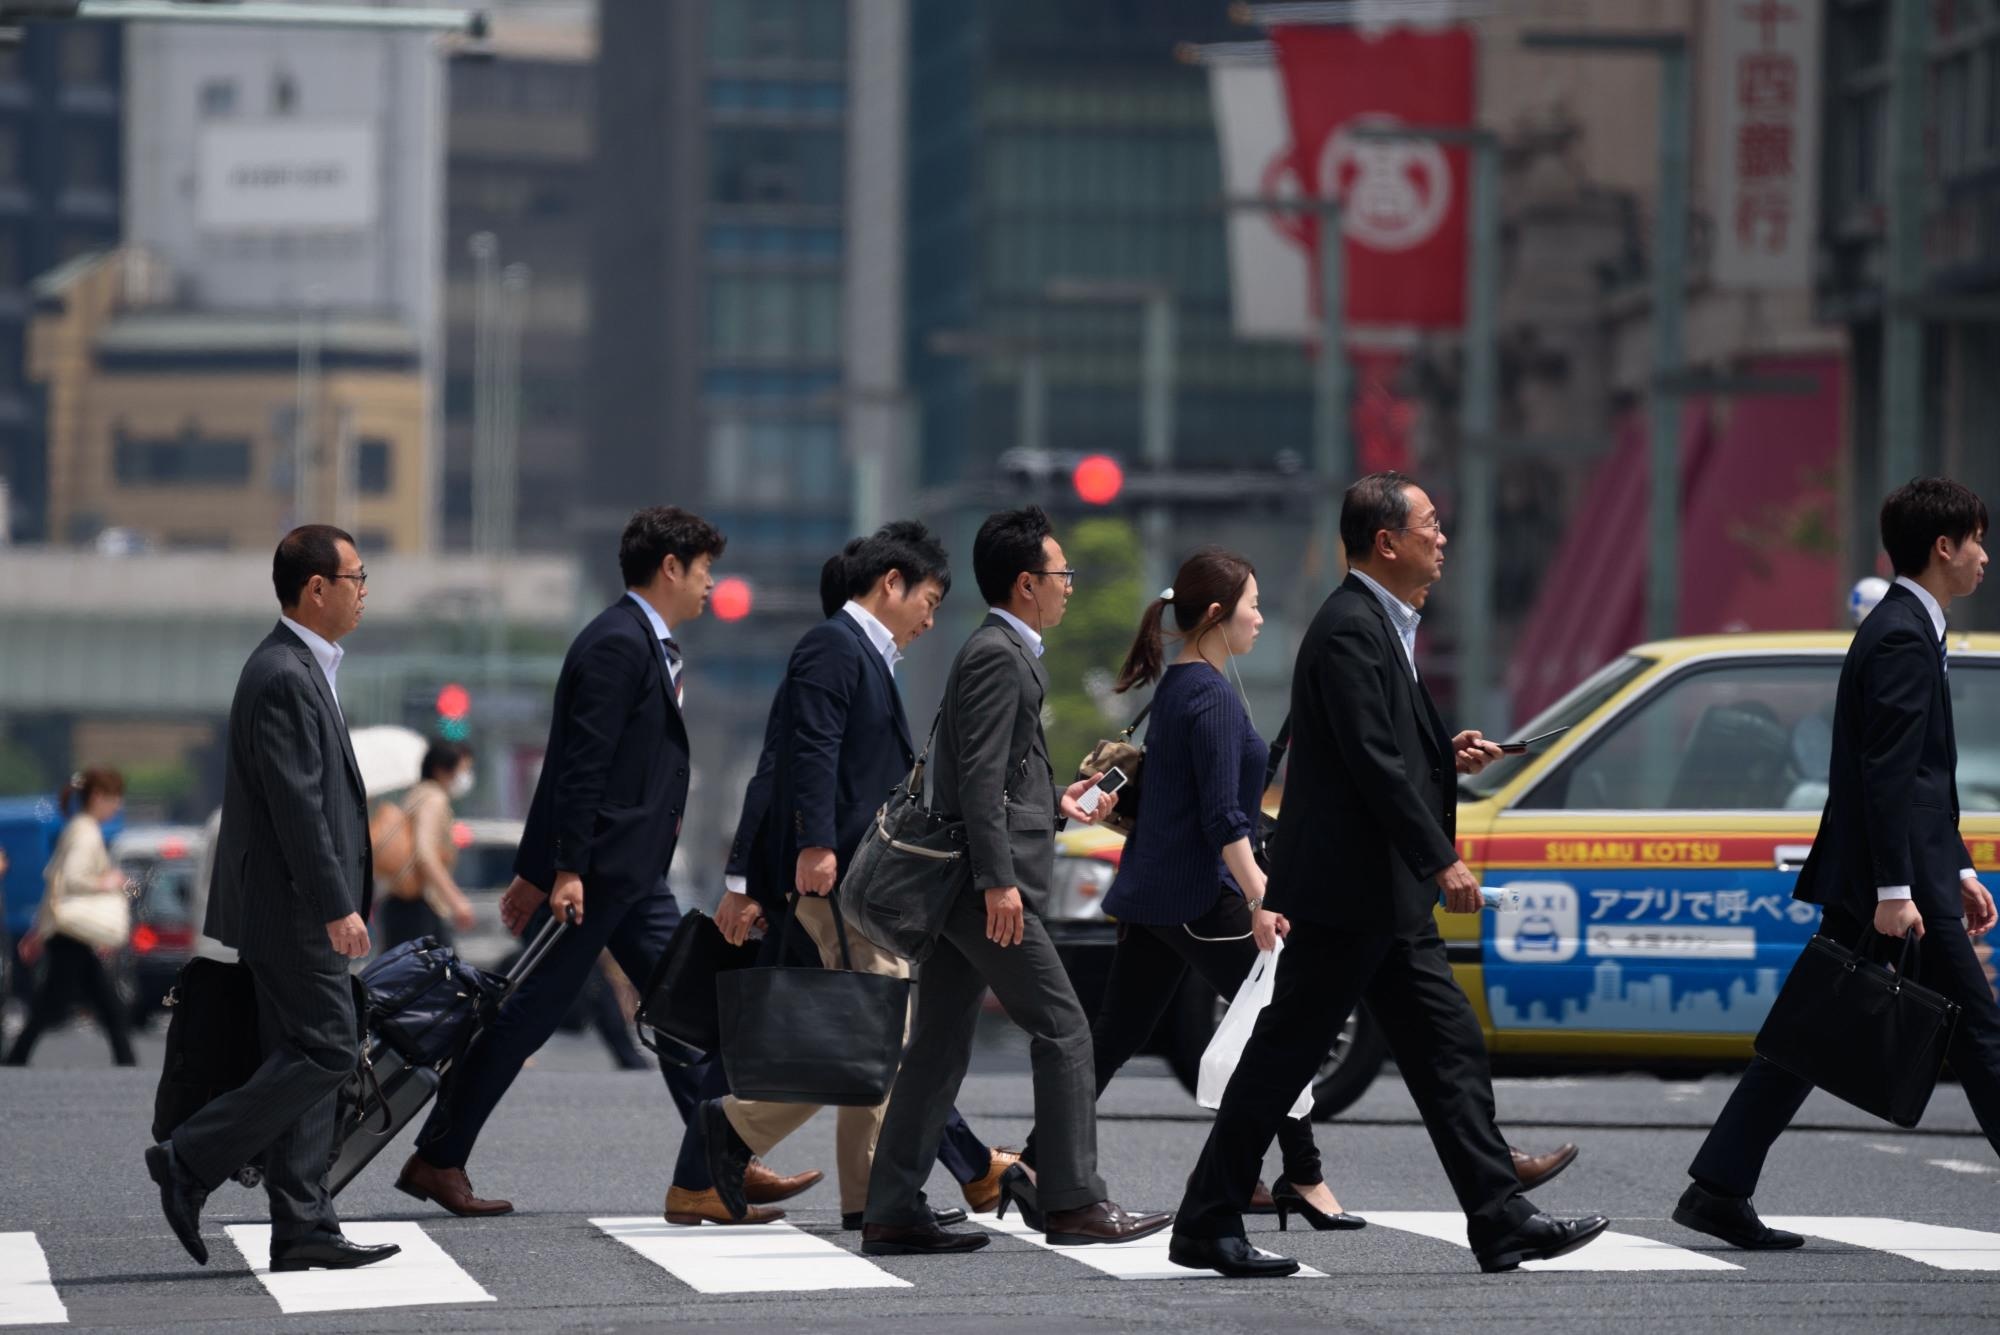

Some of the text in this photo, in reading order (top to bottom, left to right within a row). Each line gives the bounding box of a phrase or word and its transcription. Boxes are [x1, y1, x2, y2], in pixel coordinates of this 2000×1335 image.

[1545, 842, 1721, 861] SUBARU KOTSU
[1522, 893, 1568, 912] AXI
[1589, 887, 1823, 924] アプリで呼べる
